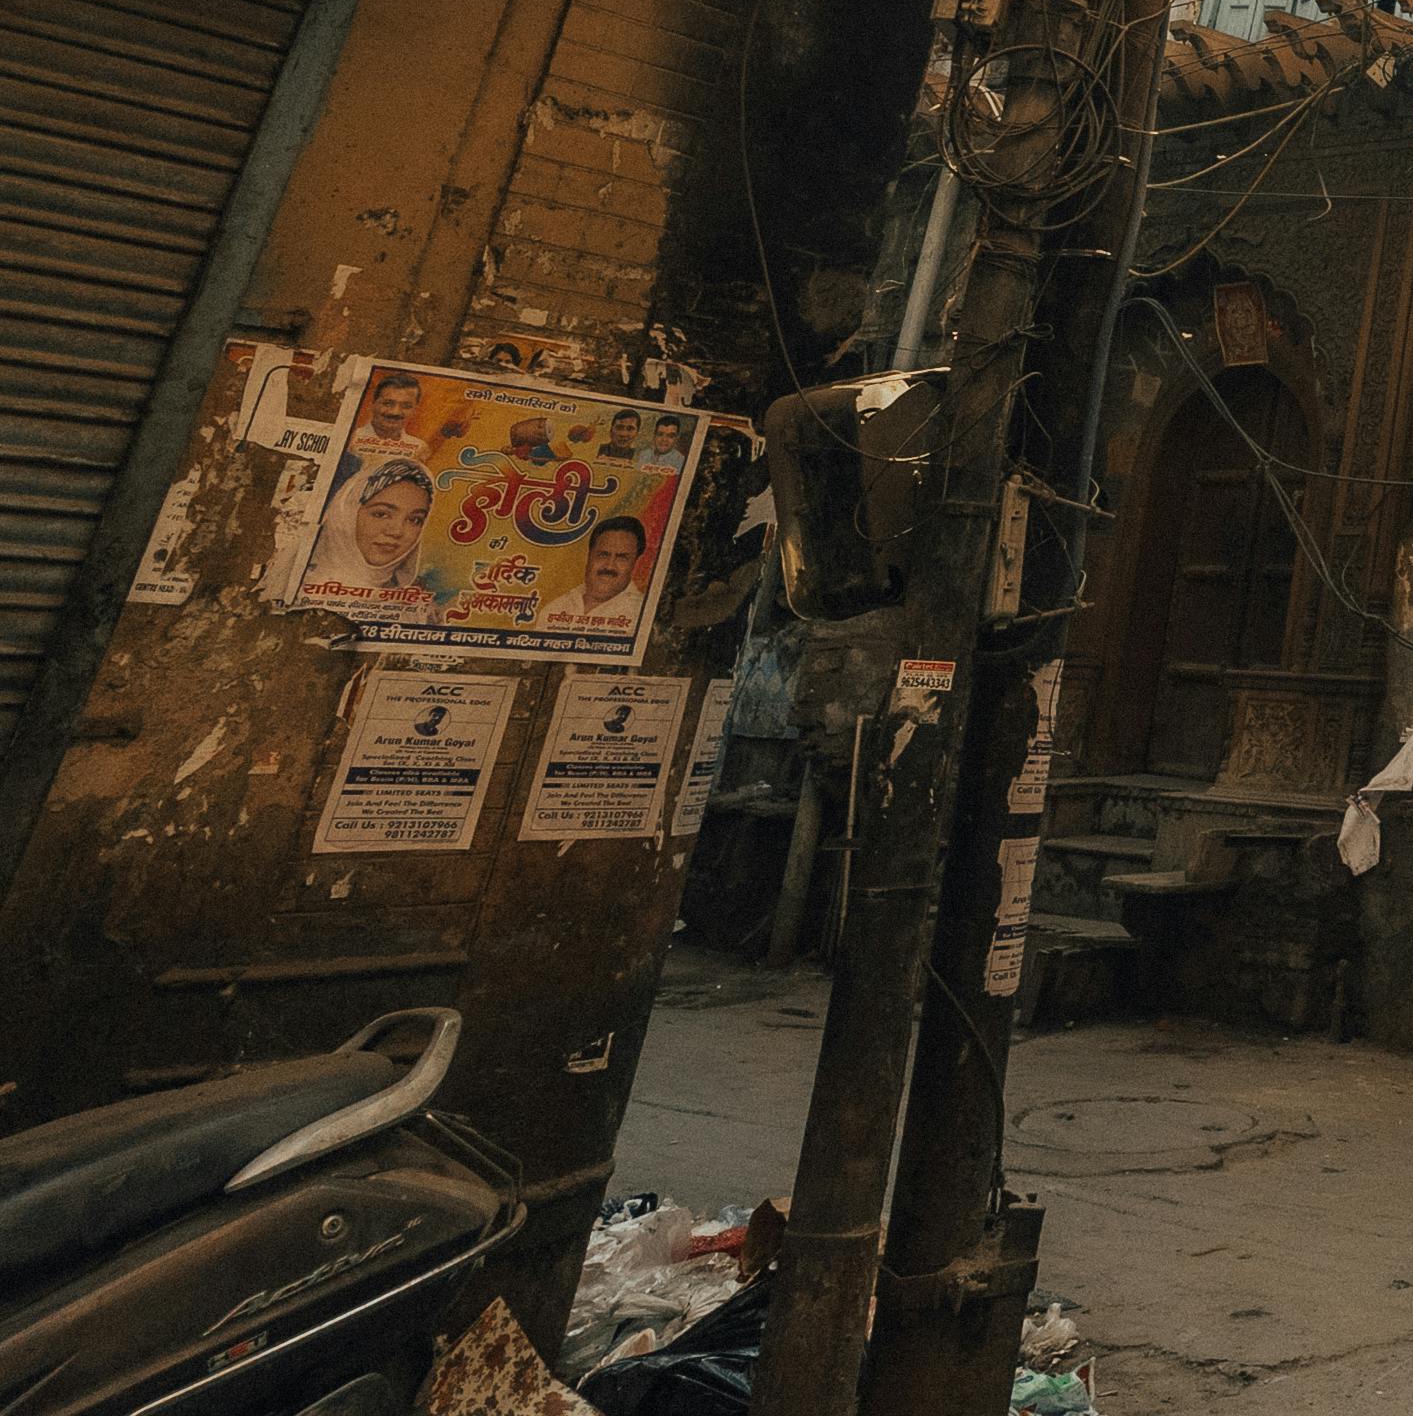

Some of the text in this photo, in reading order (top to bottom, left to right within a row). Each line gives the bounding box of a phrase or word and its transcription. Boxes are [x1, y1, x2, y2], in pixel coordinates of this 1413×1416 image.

[559, 402, 578, 414] को
[278, 428, 299, 449] AY
[438, 447, 620, 550] होली
[488, 535, 508, 551] की
[472, 553, 540, 592] हार्दिक
[421, 685, 465, 696] ACC
[608, 686, 646, 696] ACC
[386, 695, 403, 703] THE
[404, 696, 467, 705] PROFESSIONAL
[374, 735, 476, 749] Arun Kumar Goyal
[569, 733, 658, 744] Arun Kumar Goyal
[1016, 786, 1033, 794] Call
[537, 811, 559, 820] Call
[561, 811, 575, 820] Us
[334, 820, 458, 830] Call Us 9213107966
[384, 830, 456, 839] 9811242787
[992, 972, 1008, 981] Call
